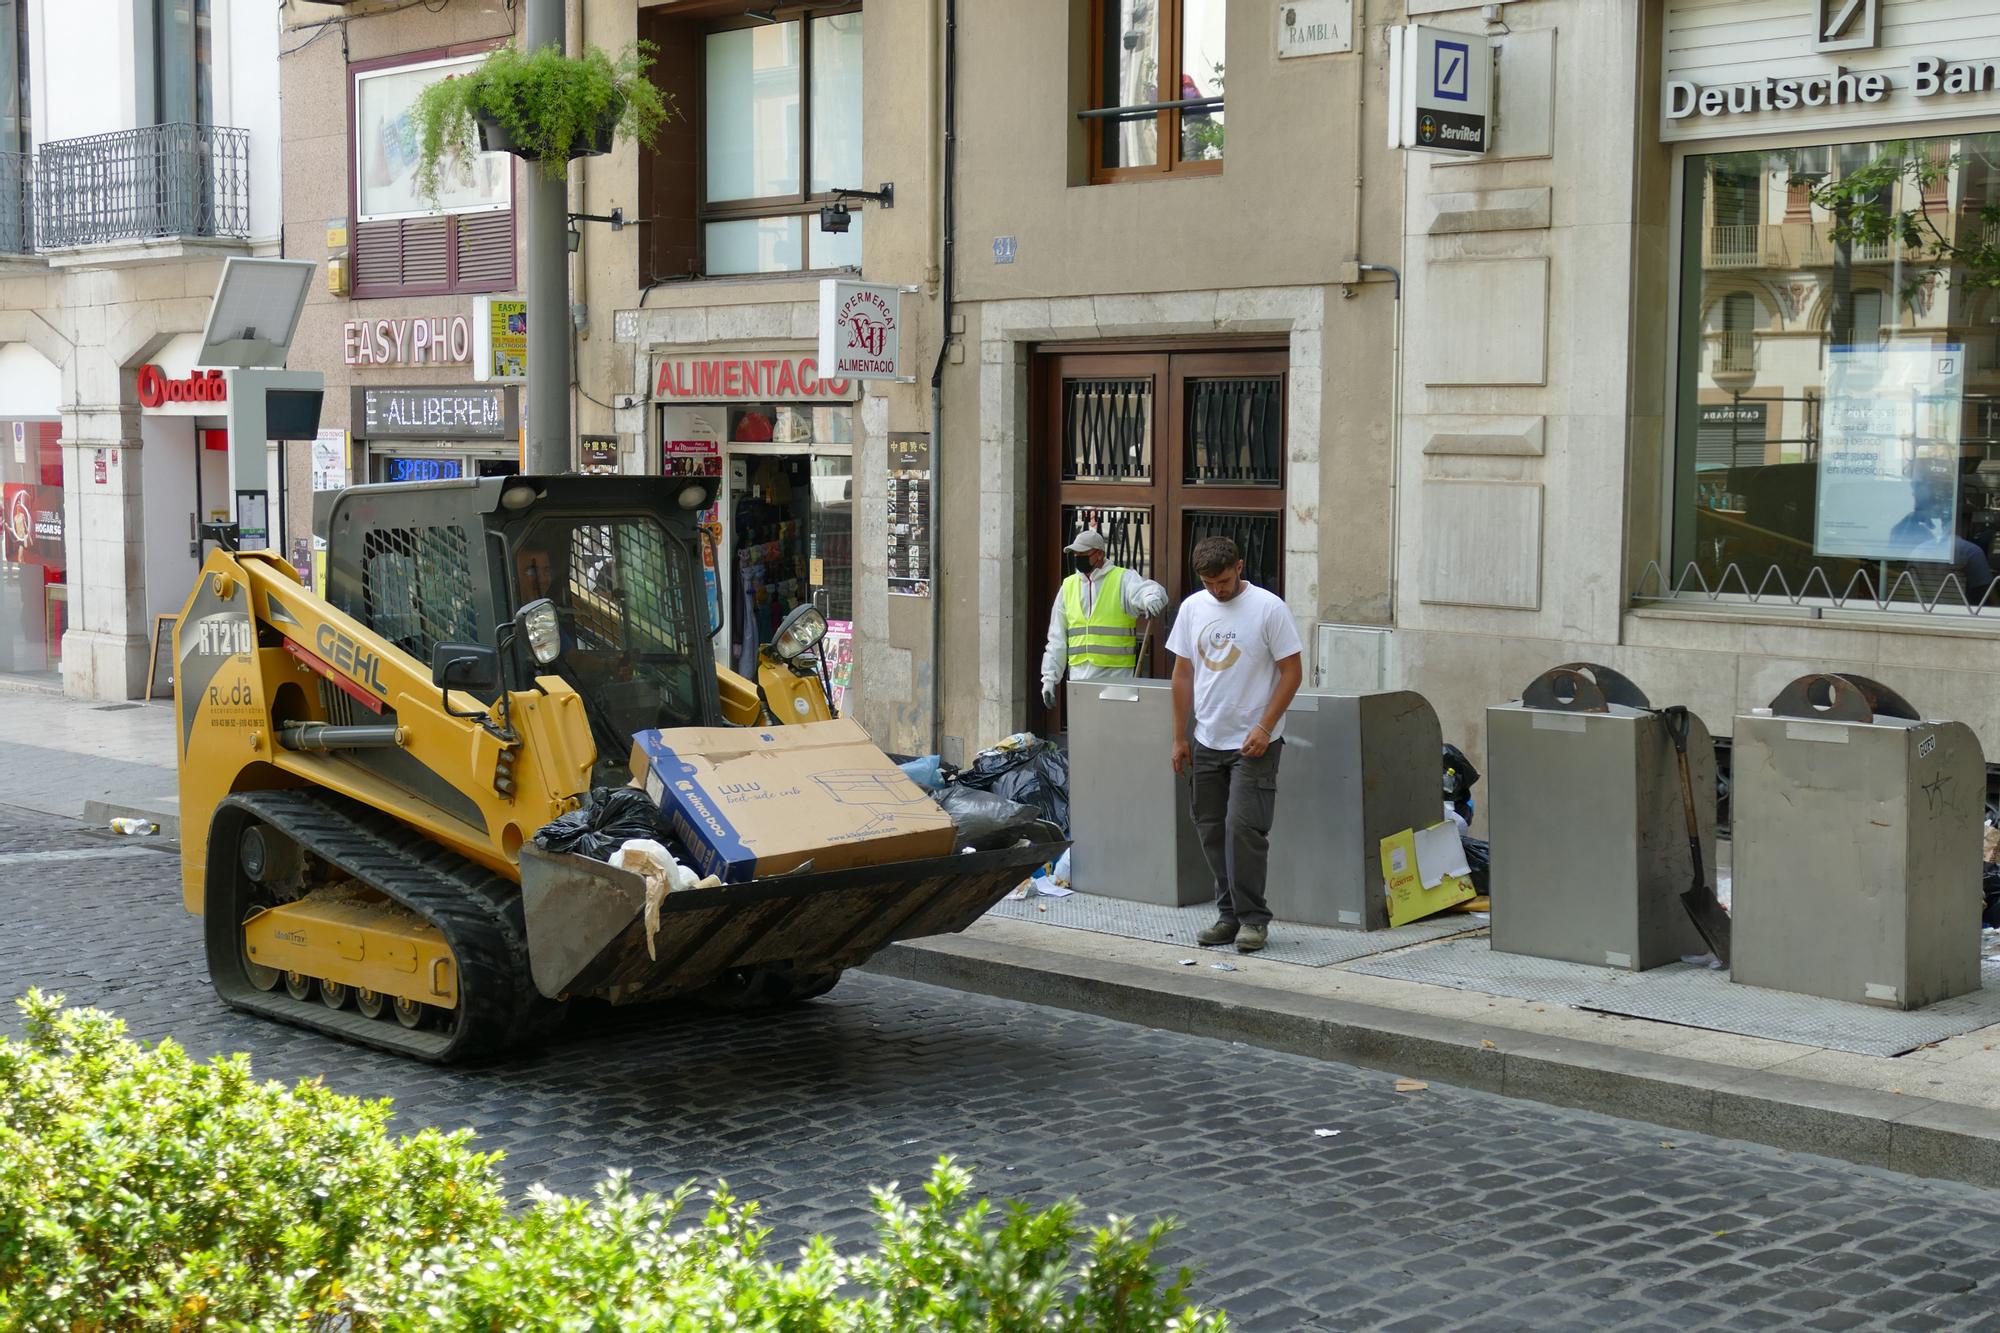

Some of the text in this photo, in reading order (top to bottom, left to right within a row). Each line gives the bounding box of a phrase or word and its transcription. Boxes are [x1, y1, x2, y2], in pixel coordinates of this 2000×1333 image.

[1289, 23, 1338, 43] RAMBLA
[1665, 65, 1888, 119] Deutsche
[1440, 123, 1481, 142] ServiRed
[996, 238, 1011, 256] 31
[498, 303, 517, 312] EASY
[837, 291, 896, 331] SUPERMERCAT
[344, 319, 407, 365] EASY
[413, 316, 469, 362] PHO
[837, 357, 895, 373] ALIMENTACIÓ
[396, 459, 440, 481] SPEED
[199, 619, 252, 656] RT210
[316, 622, 389, 696] GEHL
[718, 782, 761, 795] LULU
